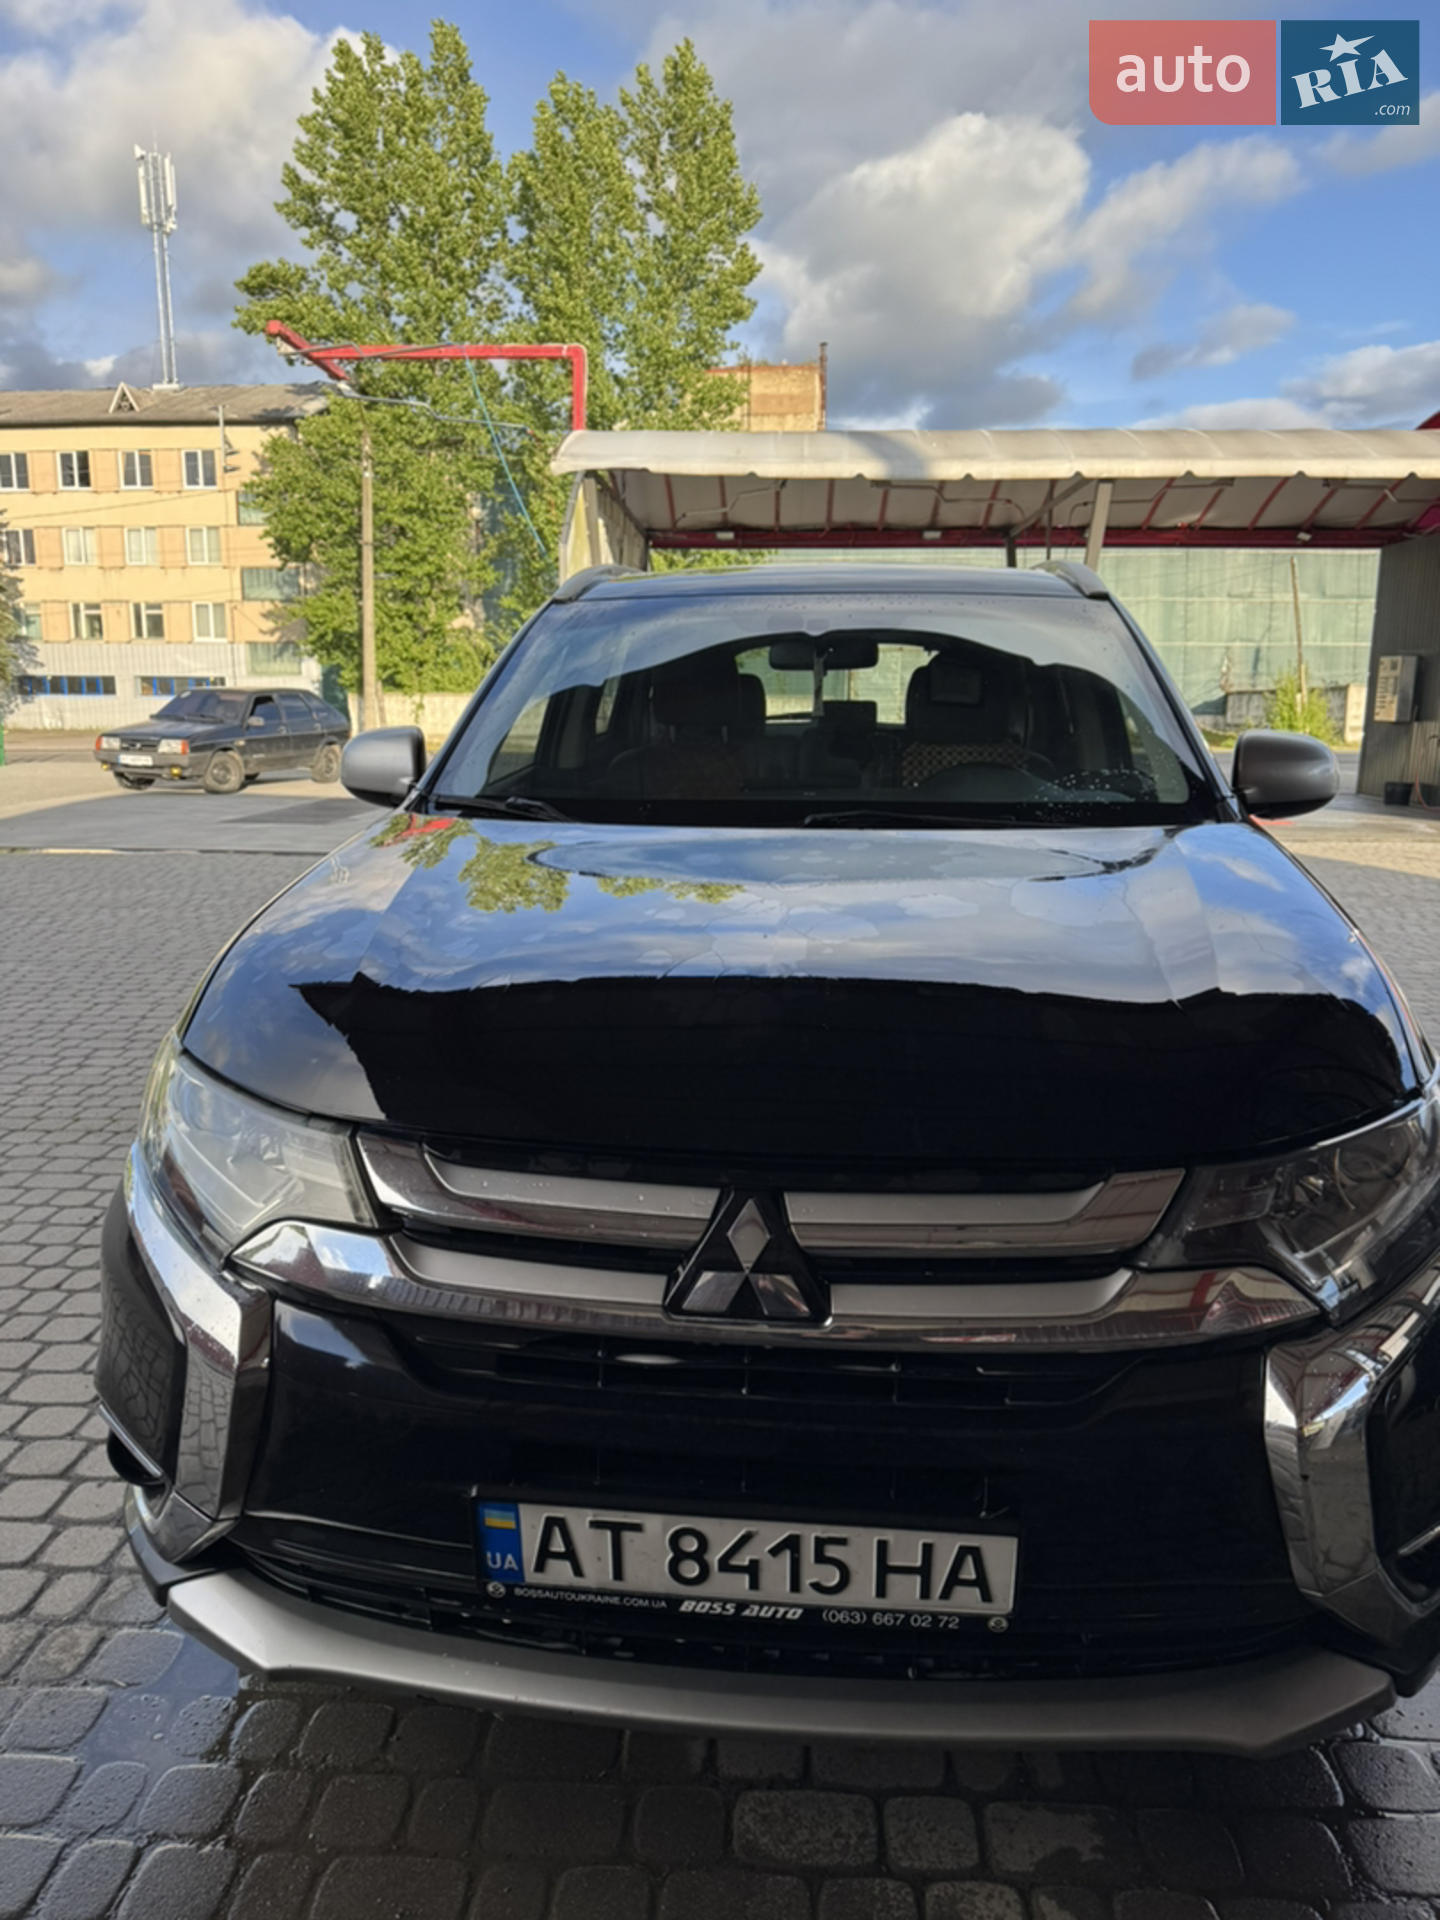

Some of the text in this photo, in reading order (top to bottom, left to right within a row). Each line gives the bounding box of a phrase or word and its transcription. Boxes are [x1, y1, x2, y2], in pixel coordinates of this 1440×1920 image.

[486, 1551, 520, 1572] UA
[533, 1514, 994, 1604] AT 8415 HA
[514, 1587, 667, 1609] BOSSAUTOUKRAINE.COM.UA
[679, 1599, 803, 1621] BOSS AUTO
[821, 1609, 960, 1629] (063) 667 02 72
